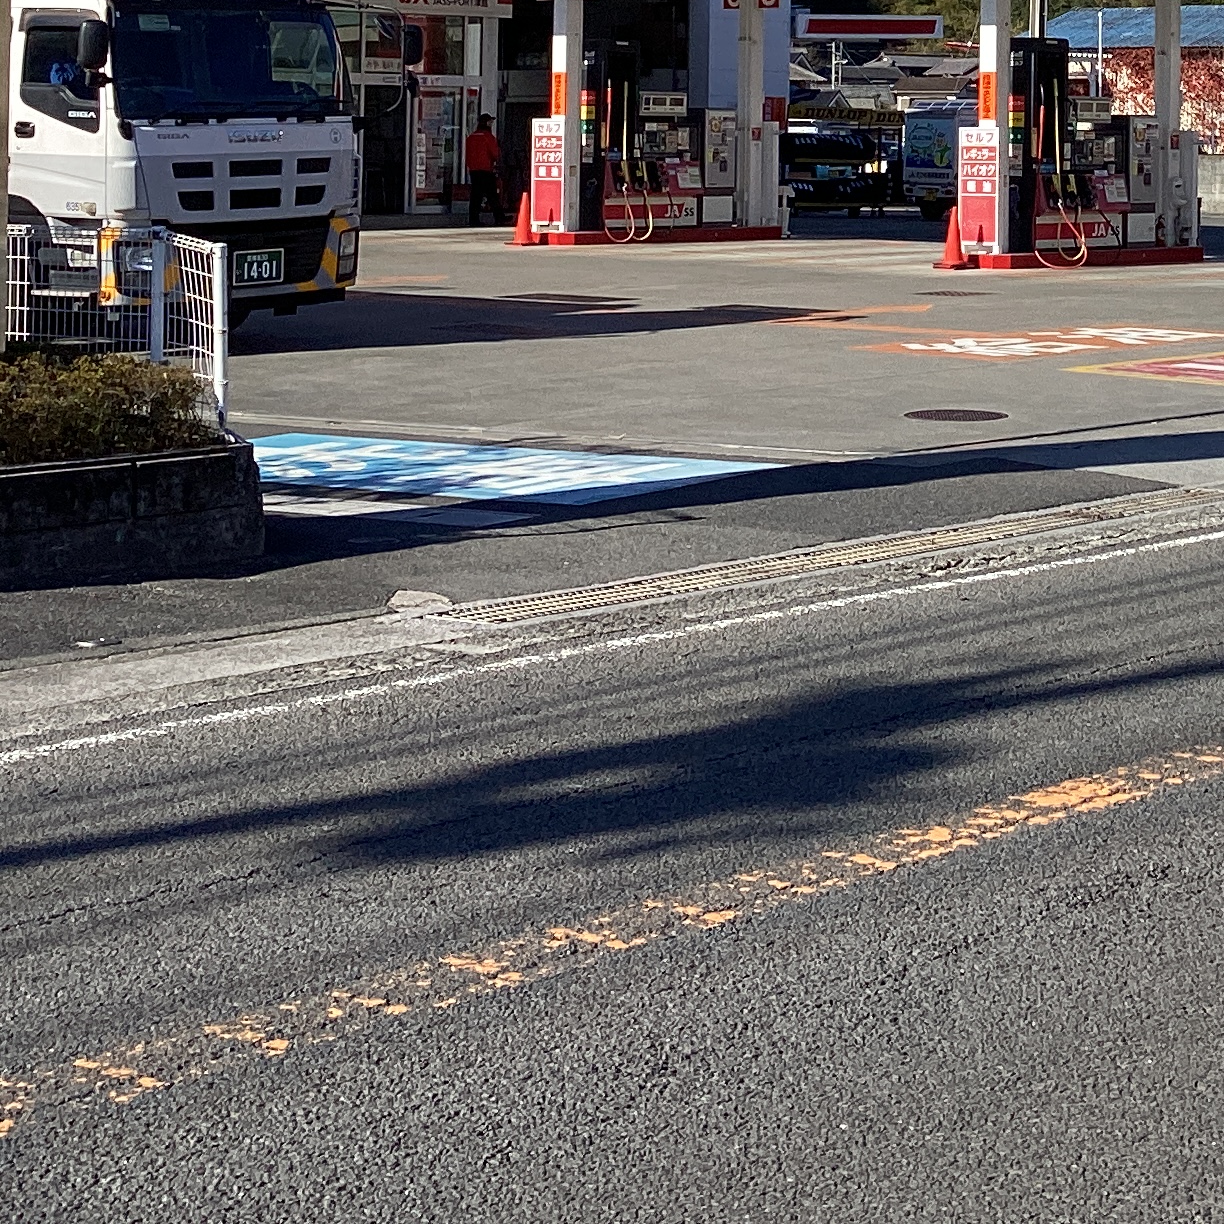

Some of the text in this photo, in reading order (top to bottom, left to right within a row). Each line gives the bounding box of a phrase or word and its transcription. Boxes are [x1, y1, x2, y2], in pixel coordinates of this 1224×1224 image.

[67, 110, 97, 118] GIGA
[804, 108, 868, 121] DUNLOP
[538, 124, 561, 133] セルフ
[535, 137, 563, 148] レギュラー
[966, 132, 994, 143] セルフ
[535, 152, 563, 163] ハイオク
[963, 148, 996, 160] レギュラー
[963, 164, 996, 176] ハイオク
[664, 205, 694, 217] JA SS
[1092, 223, 1106, 236] JA
